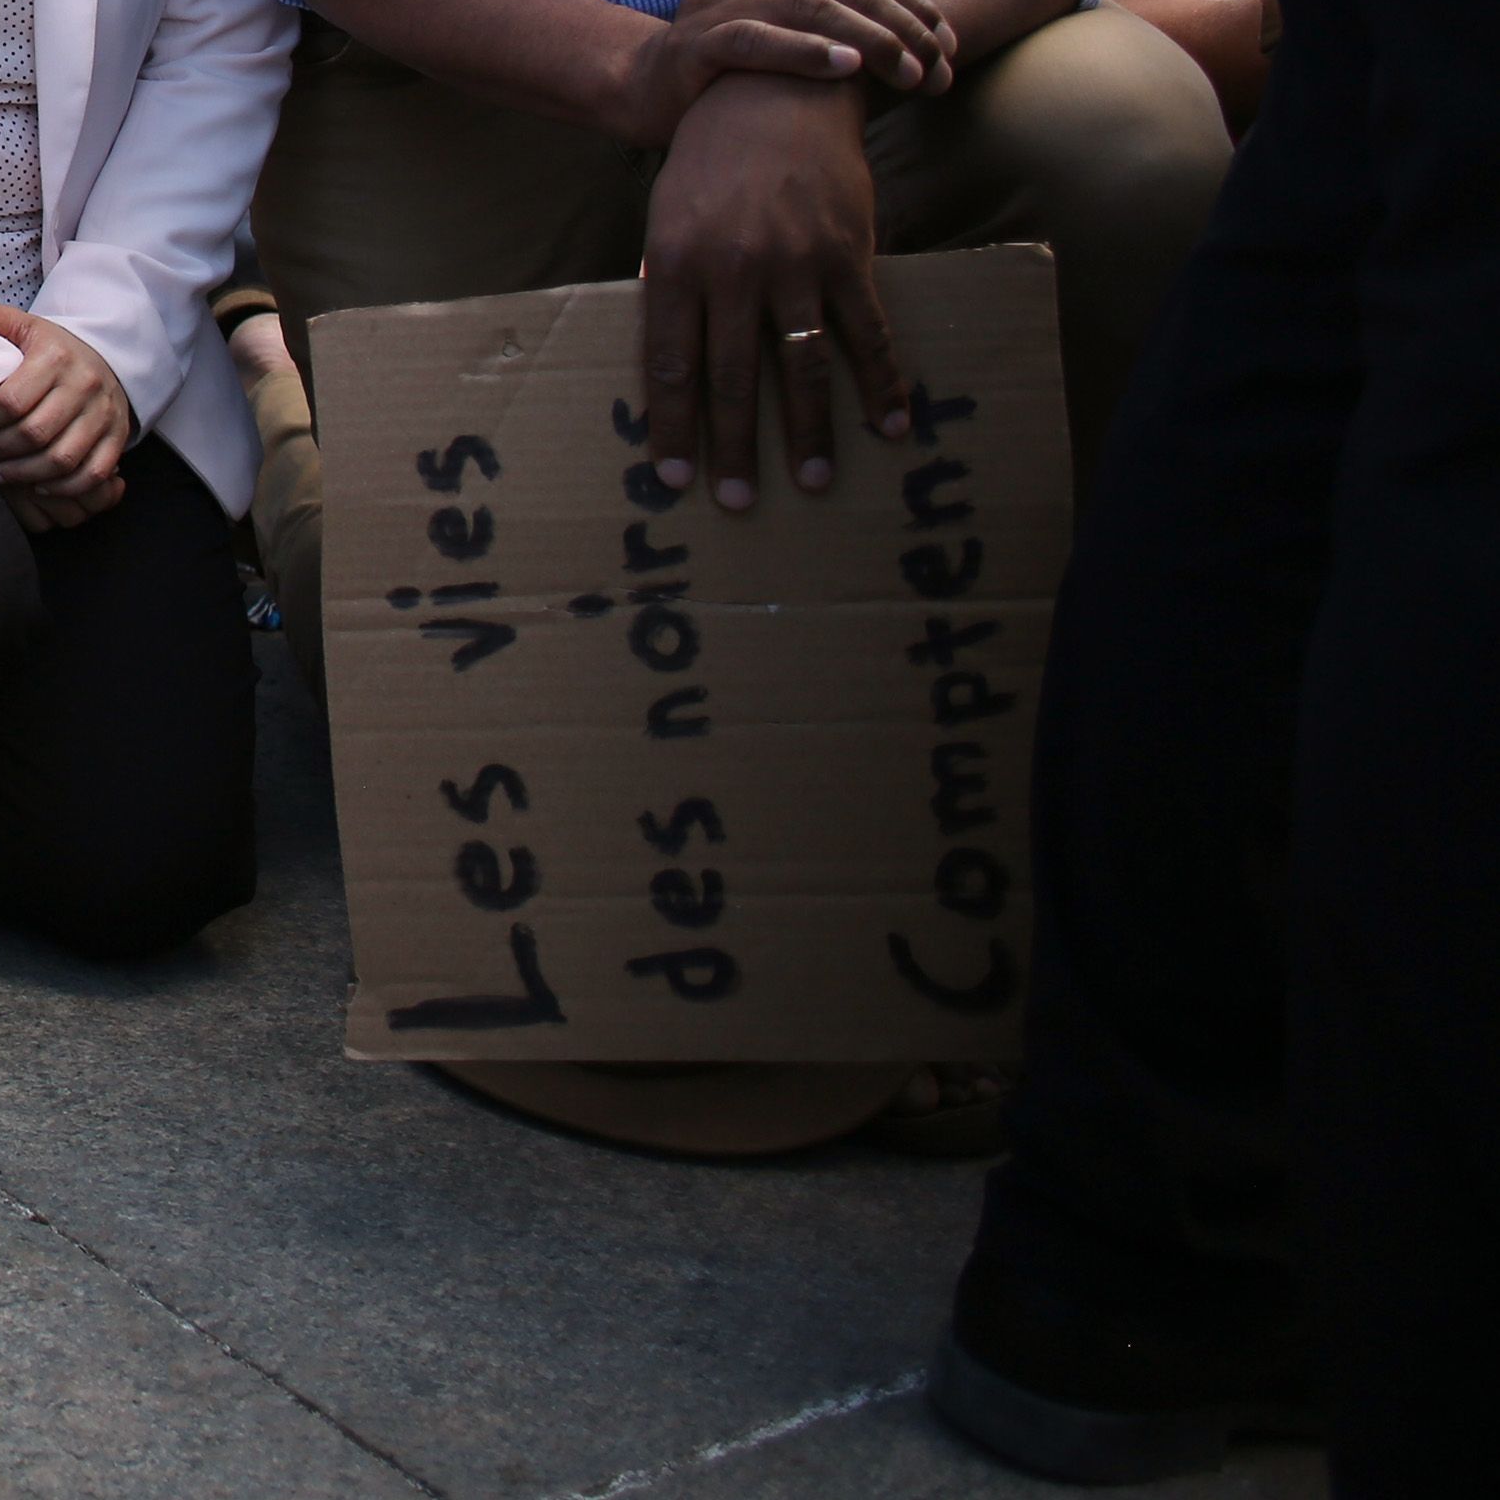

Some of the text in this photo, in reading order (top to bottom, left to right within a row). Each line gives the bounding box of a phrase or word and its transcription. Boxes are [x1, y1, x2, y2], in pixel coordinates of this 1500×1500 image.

[386, 433, 568, 1031] Les vies
[625, 796, 739, 1003] des
[863, 380, 1015, 1014] Comptent
